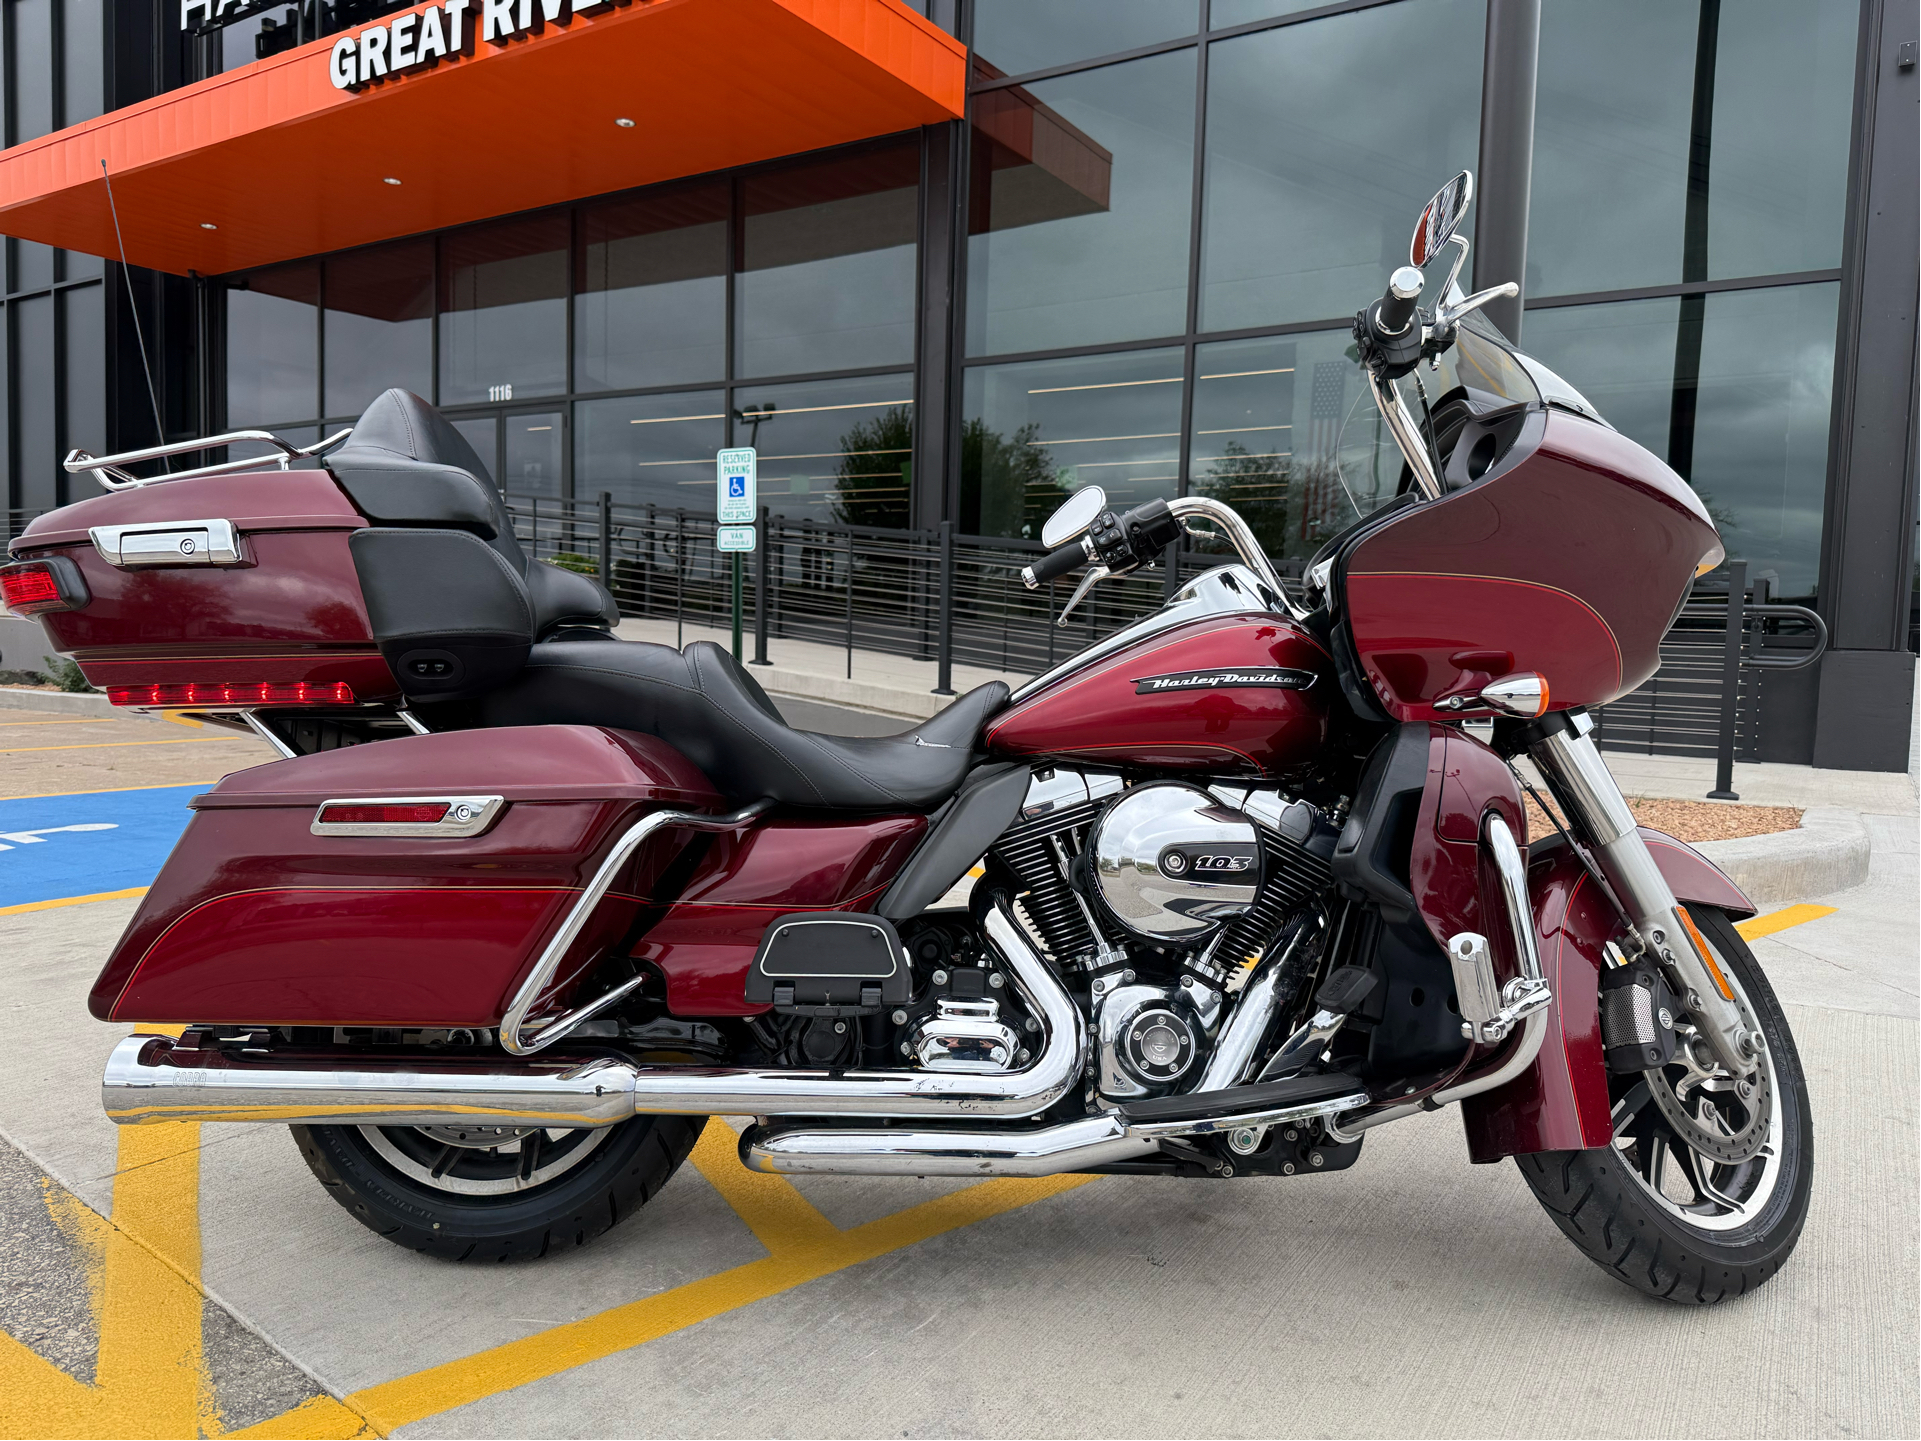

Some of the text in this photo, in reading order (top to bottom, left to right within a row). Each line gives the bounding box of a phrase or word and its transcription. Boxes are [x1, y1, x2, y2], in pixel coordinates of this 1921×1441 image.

[330, 0, 470, 90] GREAT
[489, 384, 512, 402] 1116
[722, 453, 751, 464] RESERVED
[723, 464, 750, 475] PARKING
[736, 510, 751, 518] SPACE
[730, 532, 743, 540] VAN
[1195, 855, 1253, 871] 103
